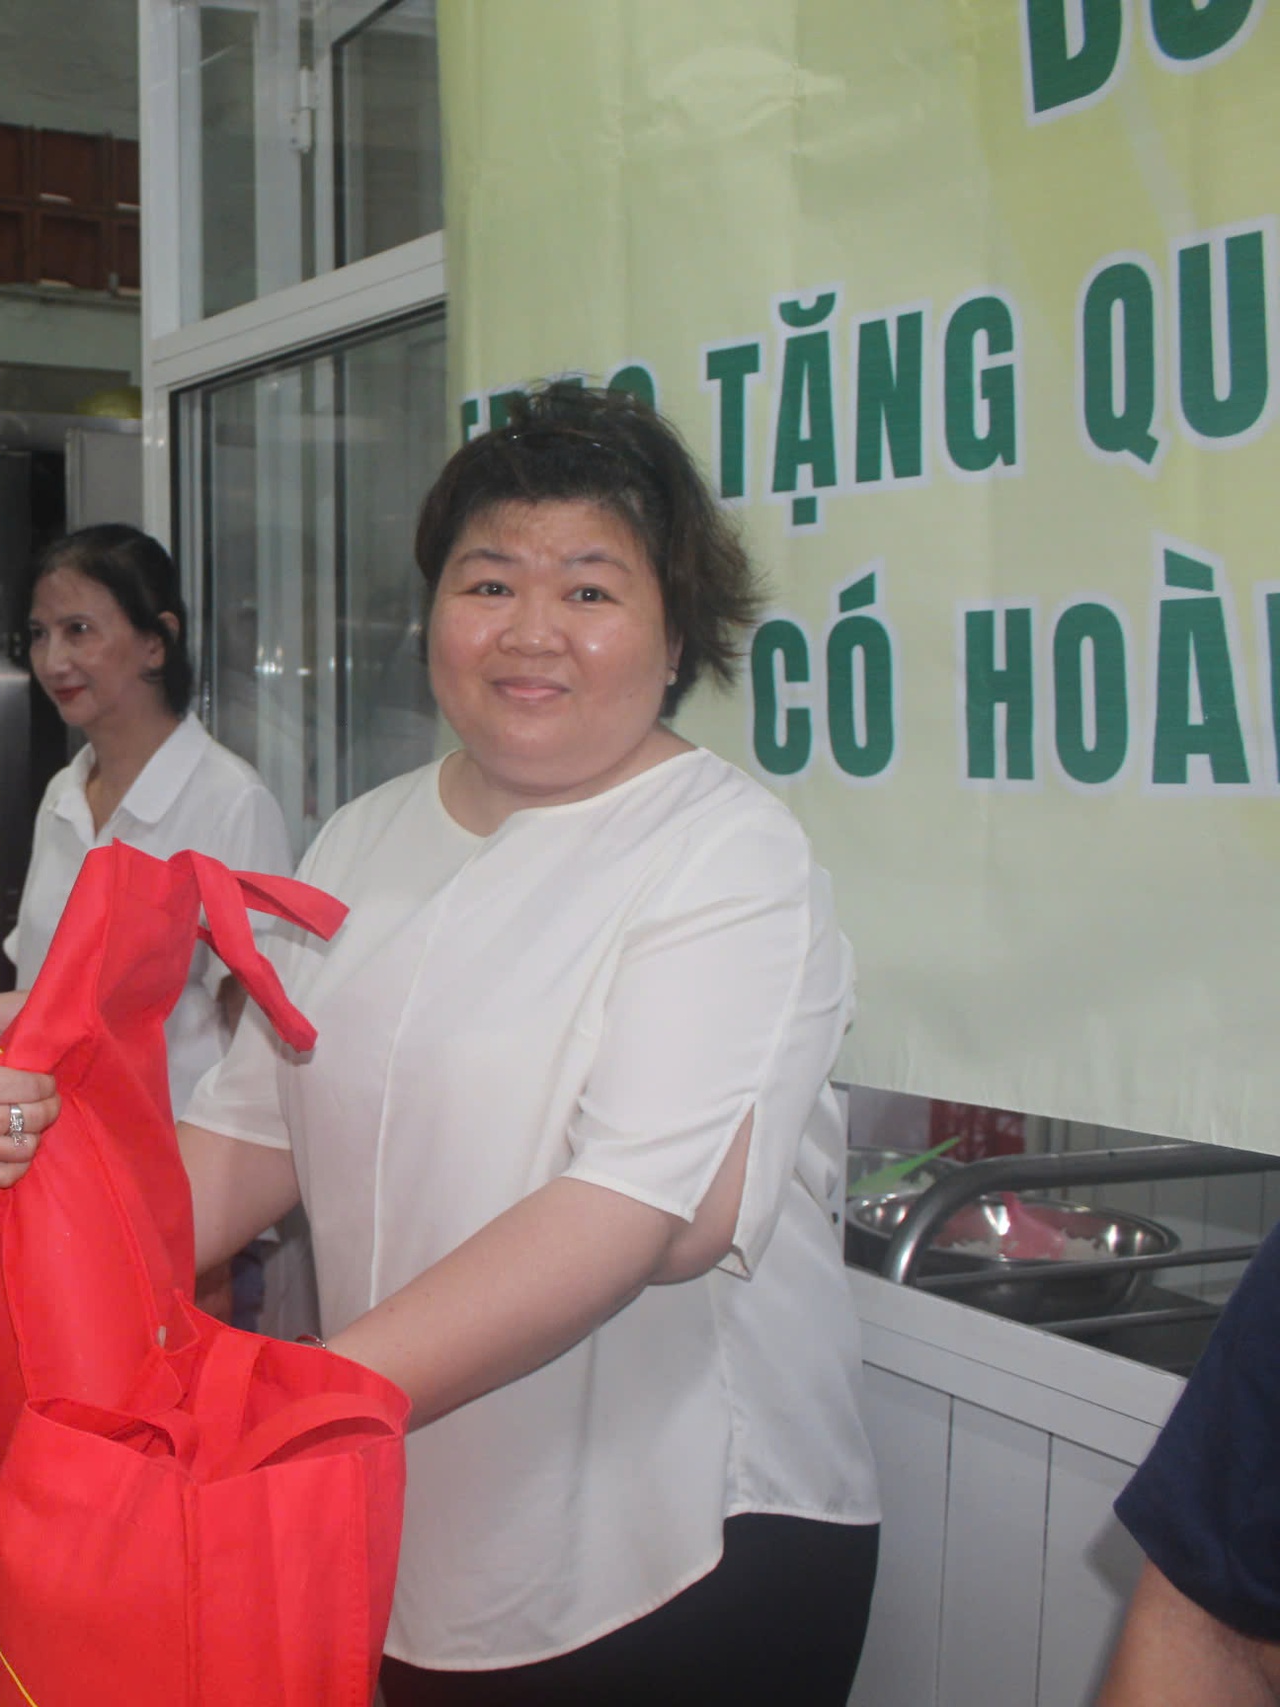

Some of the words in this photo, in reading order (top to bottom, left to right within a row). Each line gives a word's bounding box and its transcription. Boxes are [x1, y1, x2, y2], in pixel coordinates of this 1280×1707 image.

[706, 292, 1017, 525] TẶNG
[751, 571, 895, 778] CÓ
[965, 548, 1280, 784] HOÀ
